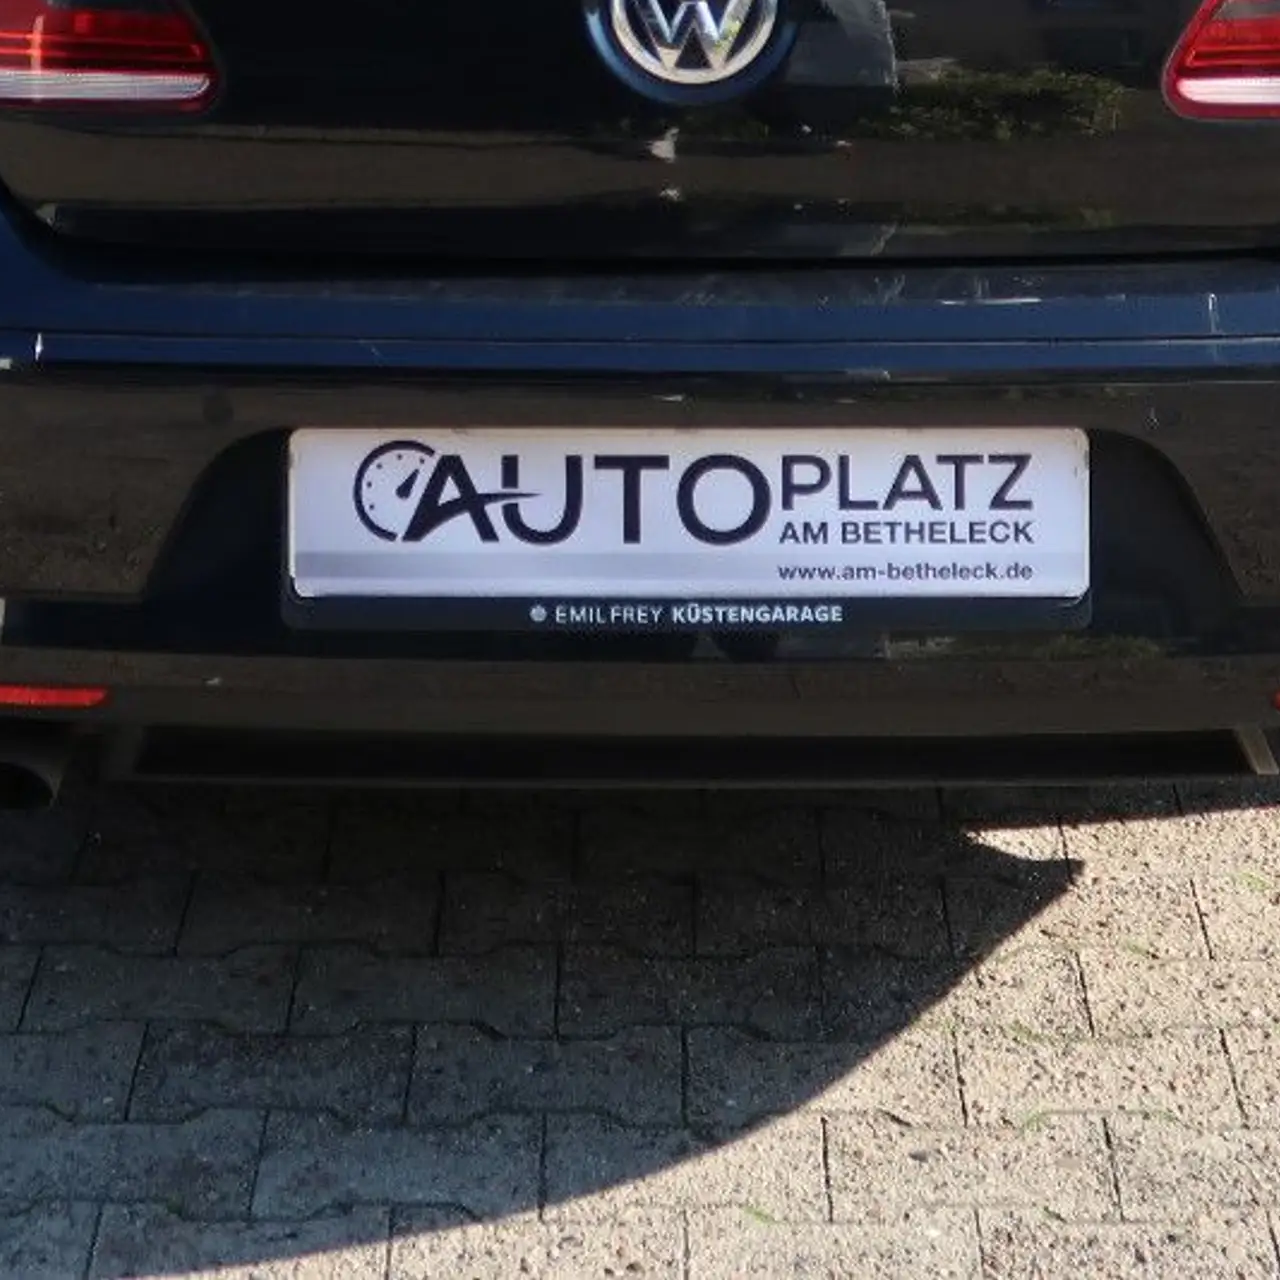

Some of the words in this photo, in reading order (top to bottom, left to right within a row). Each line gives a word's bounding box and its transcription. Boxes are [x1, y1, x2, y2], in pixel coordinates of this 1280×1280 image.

[778, 521, 828, 545] AM
[840, 520, 1035, 545] BETHELECK
[777, 561, 1033, 581] www.am-betheleck.de
[554, 605, 605, 623] EMIL
[610, 605, 664, 623] FREY
[672, 603, 844, 623] KÜSTENGARAGE
